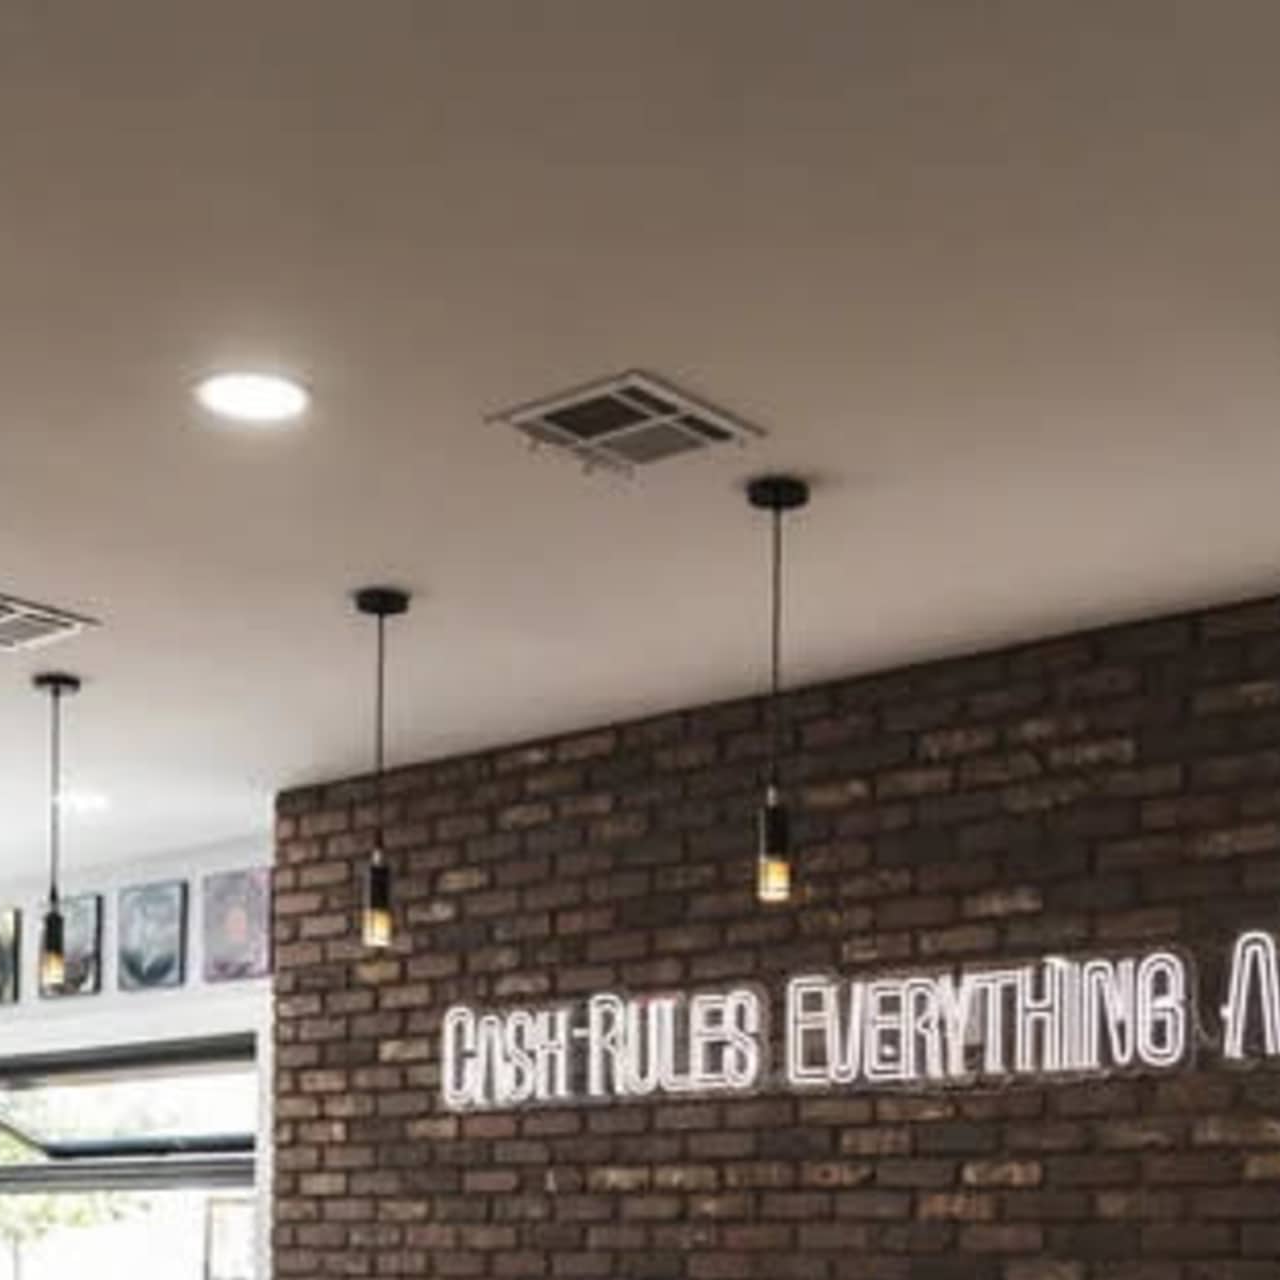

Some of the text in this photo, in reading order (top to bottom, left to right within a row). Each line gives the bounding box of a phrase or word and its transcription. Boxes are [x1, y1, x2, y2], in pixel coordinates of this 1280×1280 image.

[442, 1004, 570, 1110] CASH
[573, 989, 760, 1098] RULES
[786, 951, 1187, 1084] EVERYTHING
